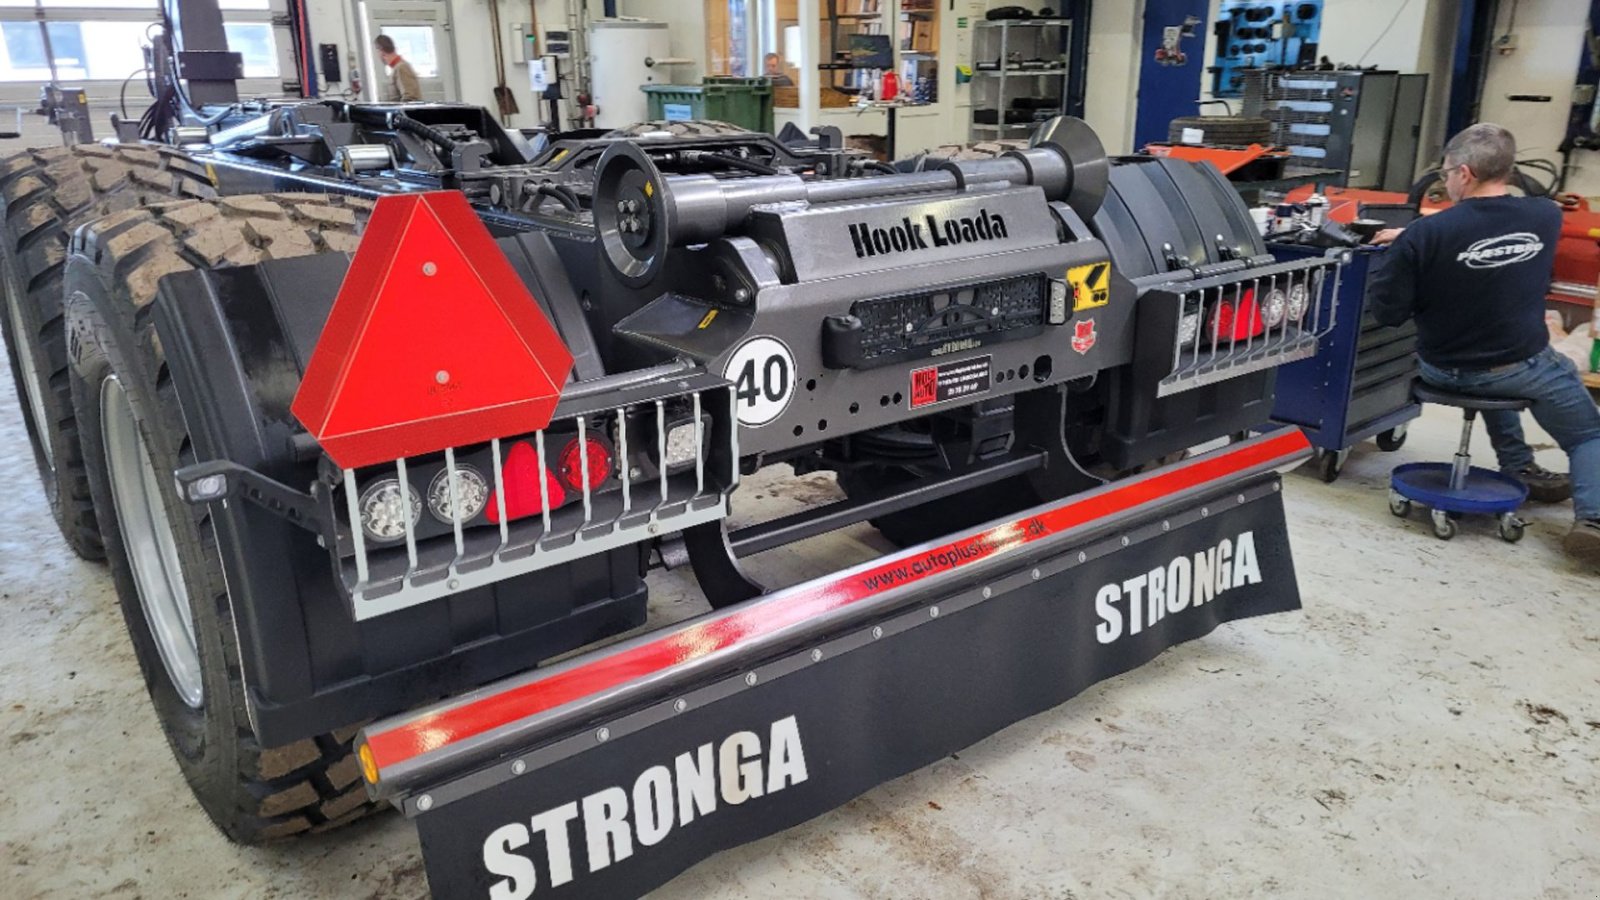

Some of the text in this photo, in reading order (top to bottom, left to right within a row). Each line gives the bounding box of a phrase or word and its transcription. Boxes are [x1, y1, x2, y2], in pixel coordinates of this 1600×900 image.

[848, 208, 1008, 259] Hook Loada
[735, 354, 788, 407] 40
[1095, 530, 1263, 644] STRONGA
[483, 715, 808, 900] STRONGA
